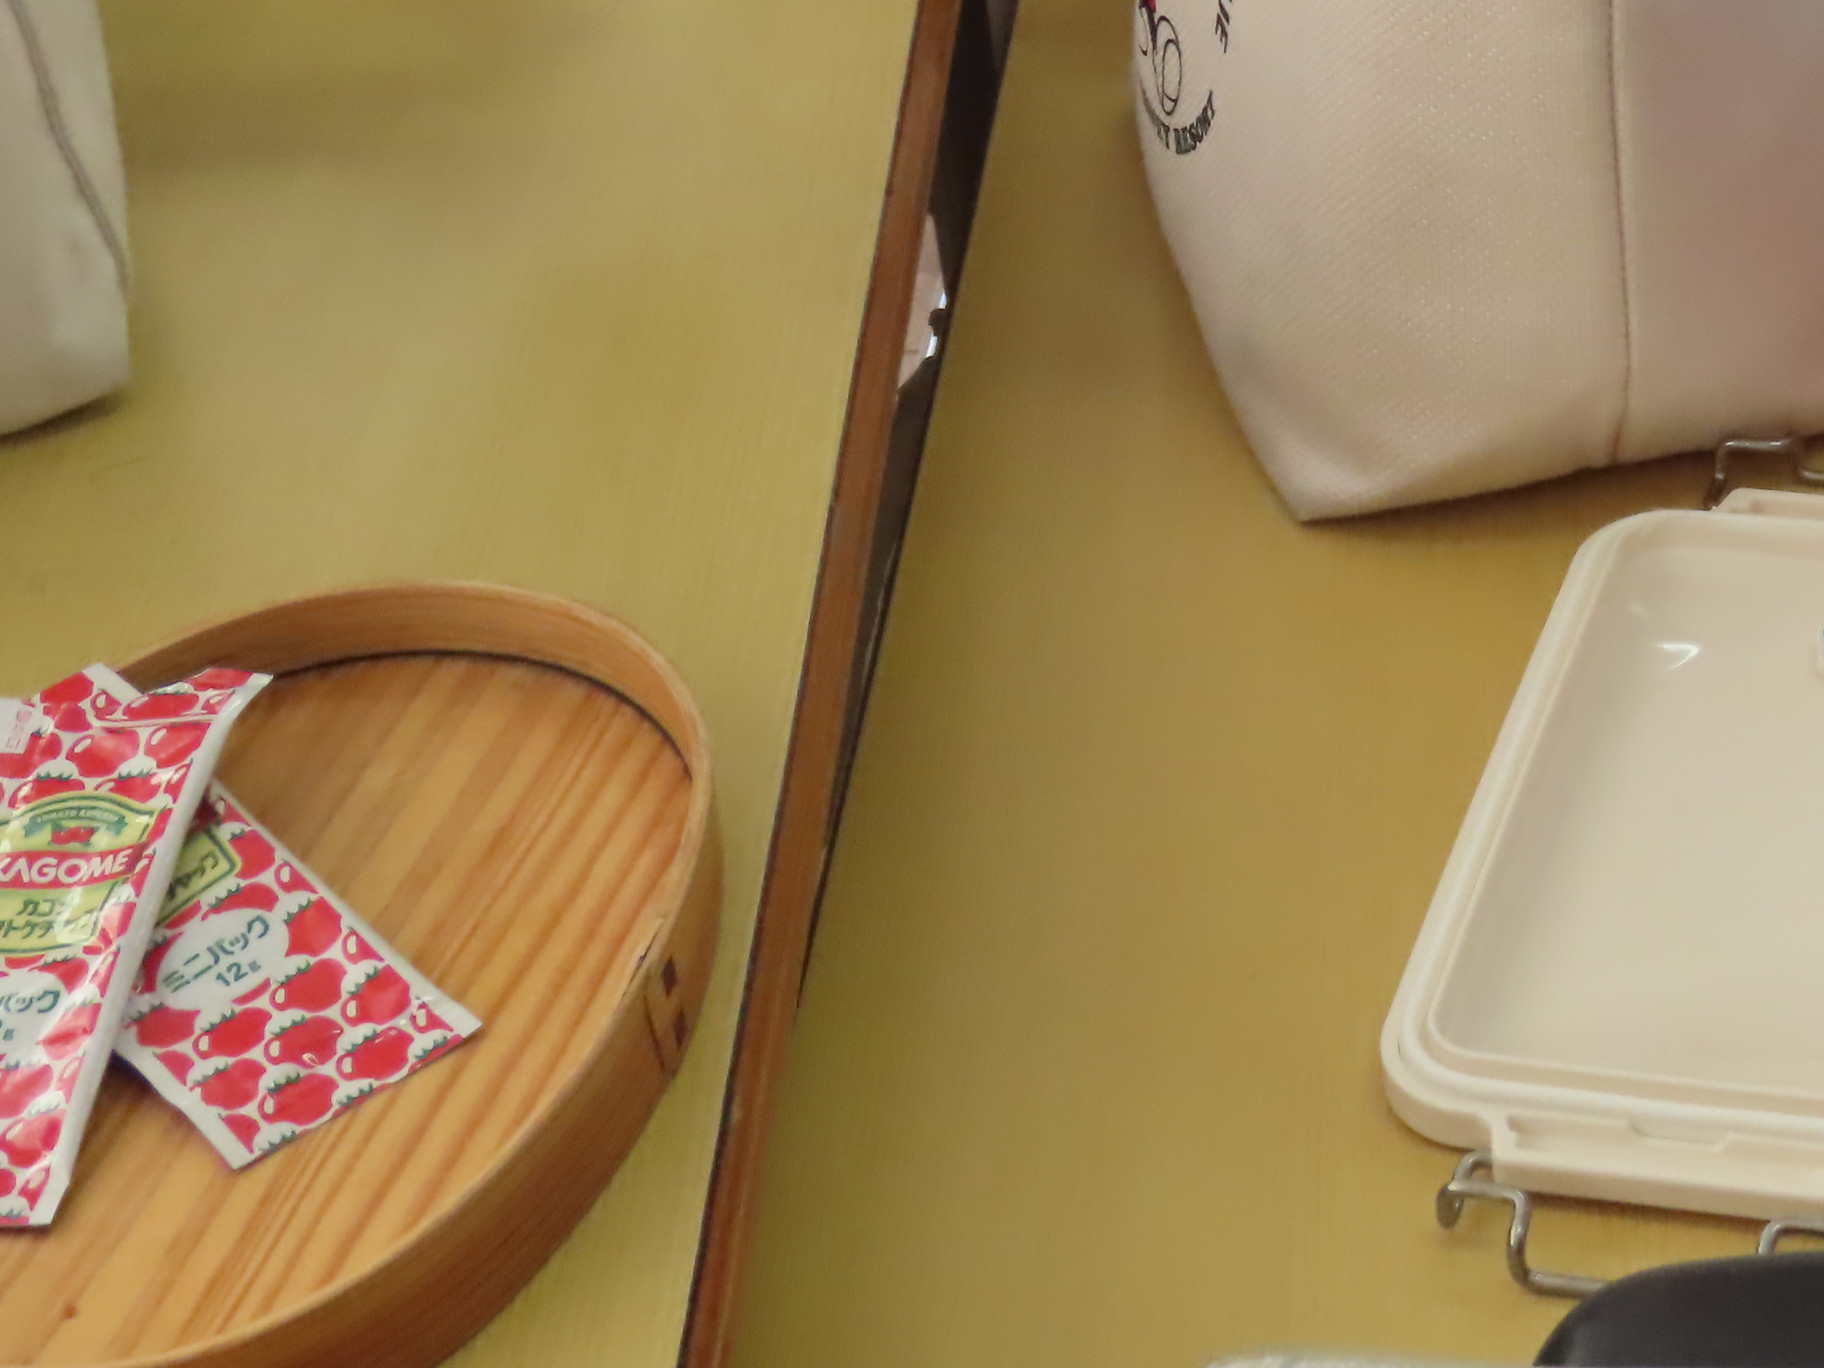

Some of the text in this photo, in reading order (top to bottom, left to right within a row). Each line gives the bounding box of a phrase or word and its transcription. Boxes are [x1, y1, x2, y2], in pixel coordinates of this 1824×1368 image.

[161, 914, 271, 993] ミニパック
